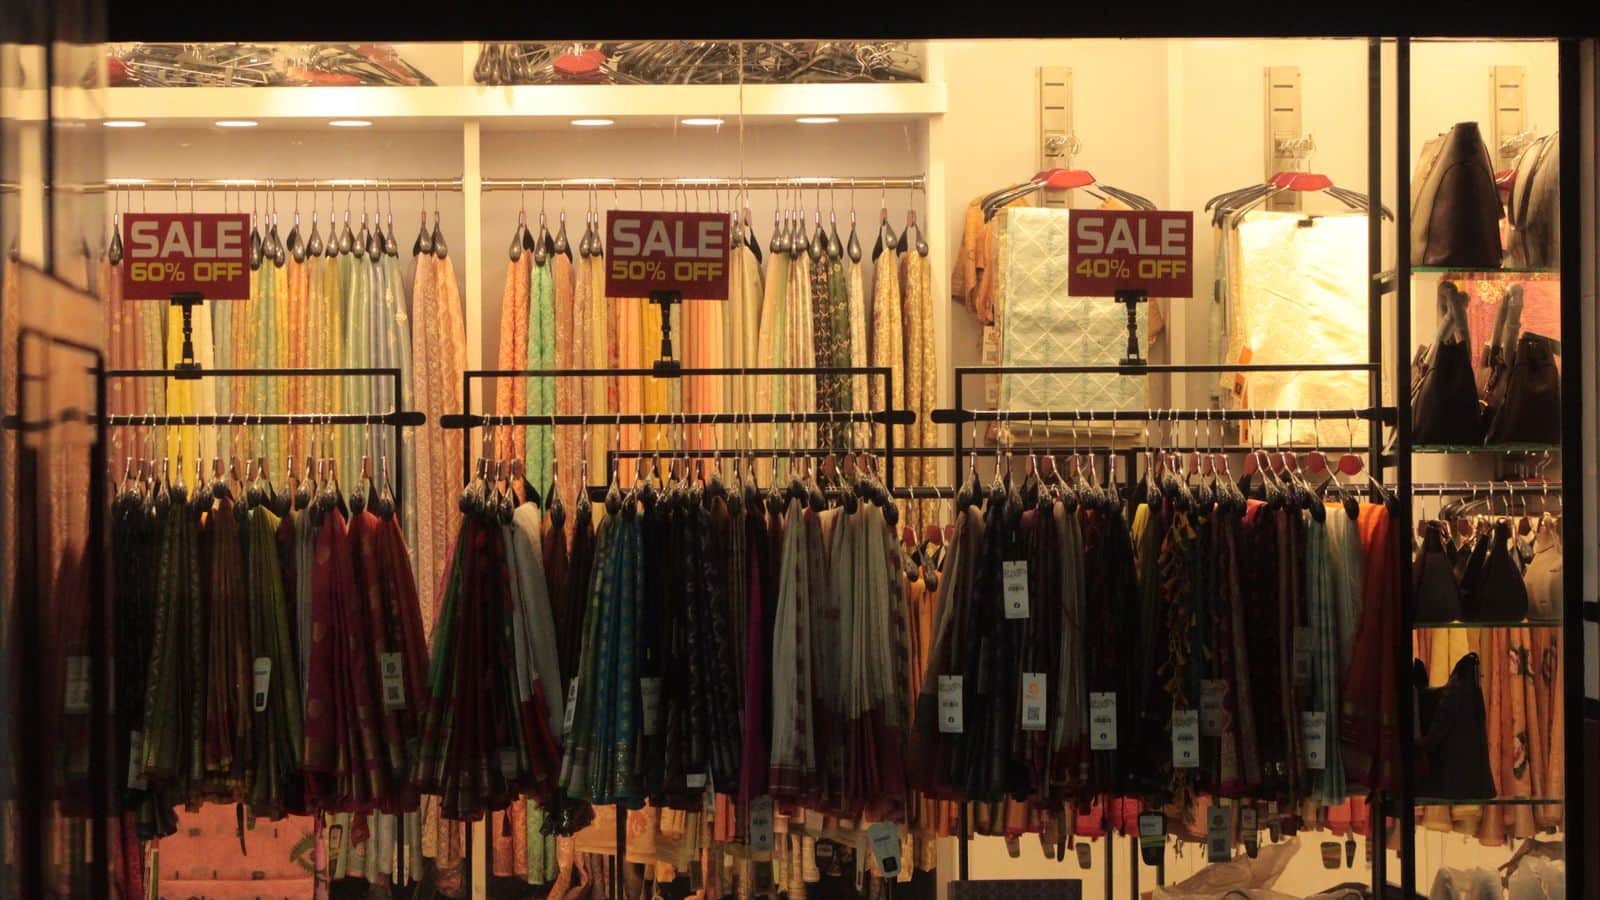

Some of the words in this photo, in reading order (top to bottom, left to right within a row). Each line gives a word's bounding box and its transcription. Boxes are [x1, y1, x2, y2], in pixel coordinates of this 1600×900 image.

[131, 220, 243, 258] SALE
[612, 219, 724, 258] SALE
[1076, 217, 1187, 255] SALE
[131, 262, 185, 281] 60%
[193, 262, 242, 281] OFF
[612, 260, 666, 280] 50%
[674, 261, 723, 281] OFF
[1076, 258, 1130, 278] 40%
[1138, 259, 1187, 279] OFF
